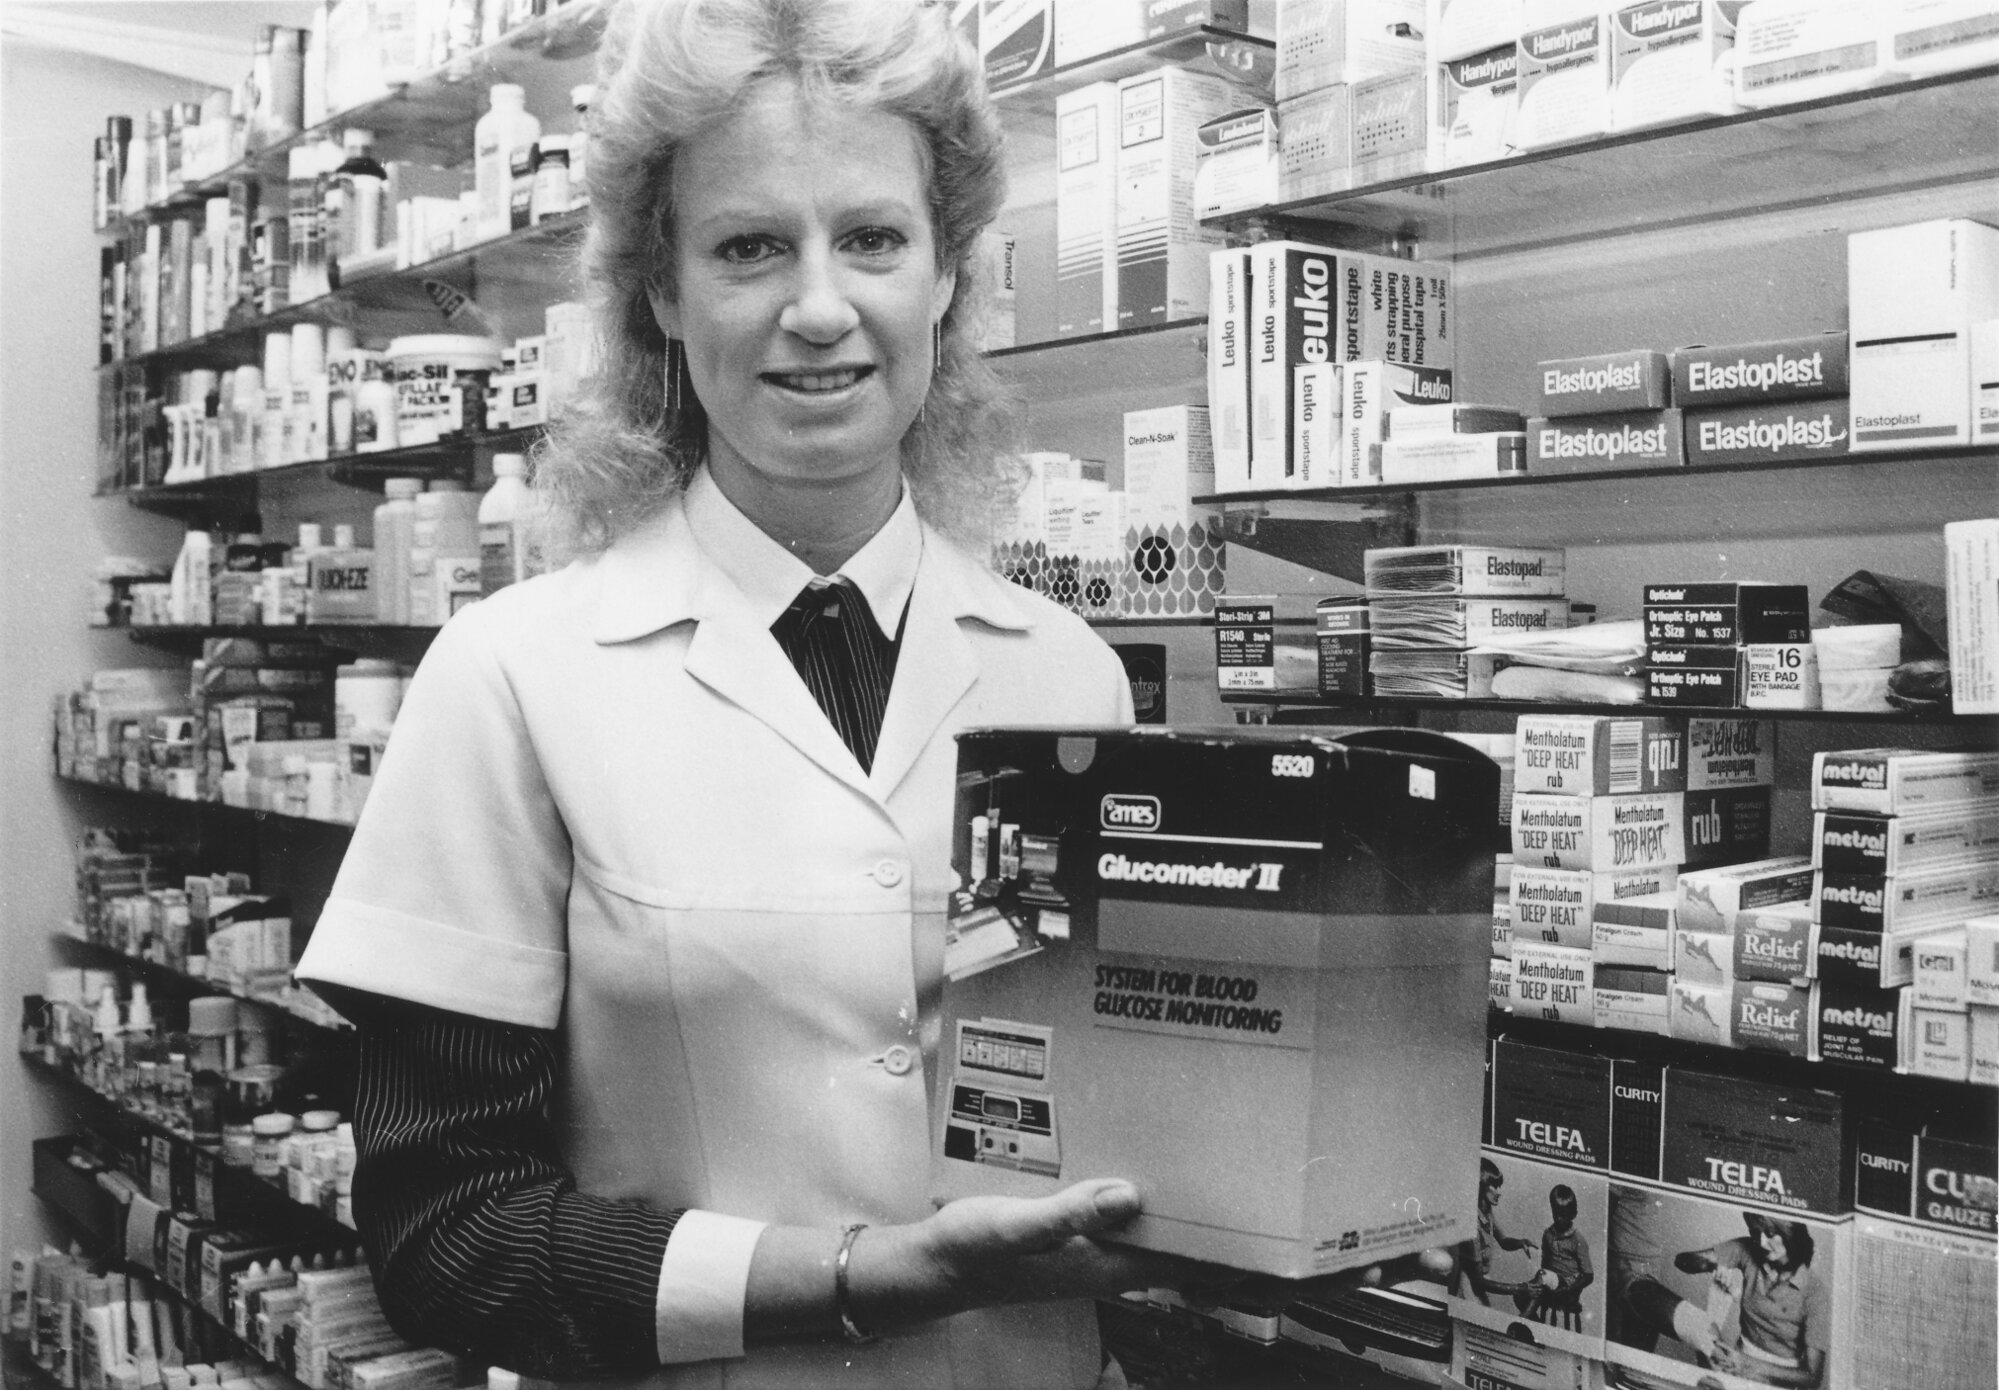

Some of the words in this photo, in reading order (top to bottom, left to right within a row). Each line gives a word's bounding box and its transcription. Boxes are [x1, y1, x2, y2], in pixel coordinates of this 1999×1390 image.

[1631, 2, 1700, 33] Handypor
[1533, 23, 1595, 55] Handypor
[1546, 53, 1595, 73] hypoallergenic
[1138, 125, 1145, 137] 2
[1004, 240, 1015, 290] Transol
[1226, 263, 1234, 312] sportstape
[1371, 270, 1382, 311] white
[1414, 276, 1426, 307] tape
[1294, 258, 1329, 363] euko
[1385, 272, 1398, 338] strapping
[1401, 274, 1412, 331] purpose
[1222, 320, 1235, 367] Leuko
[1261, 315, 1275, 363] Leuko
[1413, 310, 1426, 364] hospital
[1386, 341, 1396, 361] rts
[1544, 361, 1640, 395] Elastoplast
[1689, 352, 1823, 391] Elastoplast
[1303, 374, 1316, 422] Leuko
[1353, 371, 1368, 419] Leuko
[1414, 373, 1450, 400] Leuko
[1856, 413, 1920, 428] Elastoplast
[1128, 432, 1175, 446] Clean-N-Soak
[1539, 424, 1667, 460] Elastoplast
[1700, 415, 1832, 452] Elastoplast
[1487, 556, 1542, 580] Elastopad
[1219, 611, 1254, 622] Steri-Strip
[1492, 608, 1547, 632] Elastopad
[1649, 611, 1683, 622] Orthoptic
[1685, 611, 1699, 623] Eye
[1700, 611, 1722, 622] Patch
[1220, 630, 1245, 642] R1540
[1650, 624, 1662, 638] Jr.
[1664, 624, 1685, 638] Size
[1695, 627, 1709, 638] No.
[1712, 627, 1731, 638] 1537
[1777, 647, 1801, 668] 16
[1651, 672, 1684, 686] Orthoptic
[1686, 673, 1699, 686] Eye
[1700, 674, 1722, 685] Patch
[1750, 672, 1770, 682] EYE
[1775, 672, 1798, 682] PAD
[1651, 686, 1661, 697] No.
[1662, 686, 1677, 697] 1539
[1525, 729, 1586, 748] Mentholatum
[1271, 754, 1315, 778] 5520
[1649, 740, 1679, 786] rub
[1707, 759, 1756, 777] Mentholatum
[1823, 762, 1885, 781] metsal
[1547, 771, 1563, 788] rub
[1109, 804, 1155, 824] ames
[1521, 809, 1582, 827] Mentholatum
[1615, 804, 1664, 825] Mentholatum
[1692, 799, 1721, 845] rub
[1824, 830, 1885, 850] metsal
[1544, 852, 1560, 868] rub
[1097, 853, 1253, 890] Glucometer
[1255, 863, 1284, 892] II
[1519, 882, 1582, 903] Mentholatum
[1614, 880, 1660, 899] Mentholatum
[1822, 886, 1882, 907] metsal
[1542, 926, 1559, 942] rub
[1744, 933, 1803, 960] Relief
[1819, 942, 1879, 963] metsal
[1520, 959, 1584, 982] Mentholatum
[1094, 964, 1156, 992] SYSTEM
[1158, 970, 1193, 997] FOR
[1195, 974, 1258, 1002] BLOOD
[1094, 991, 1164, 1021] GLUCOSE
[1165, 999, 1282, 1034] MONITORING
[1542, 1004, 1560, 1020] rub
[1740, 1003, 1799, 1029] Relief
[1823, 1007, 1893, 1031] metsal
[1823, 1034, 1847, 1043] RELIEF
[1823, 1042, 1844, 1051] JOINT
[1847, 1045, 1863, 1053] AND
[1823, 1051, 1864, 1062] MUSCULAR
[1866, 1056, 1884, 1064] PAIN
[1614, 1085, 1661, 1104] CURITY
[1515, 1117, 1586, 1152] TELFA
[1506, 1138, 1534, 1151] WOUND
[1535, 1144, 1574, 1160] DRESSING
[1575, 1152, 1596, 1163] PADS
[1860, 1152, 1910, 1174] CURITY
[1705, 1157, 1786, 1195] TELFA
[1687, 1177, 1726, 1193] WOUND
[1727, 1185, 1779, 1203] DRESSING
[1781, 1197, 1808, 1209] PADS
[1927, 1202, 1992, 1229] GAUZE
